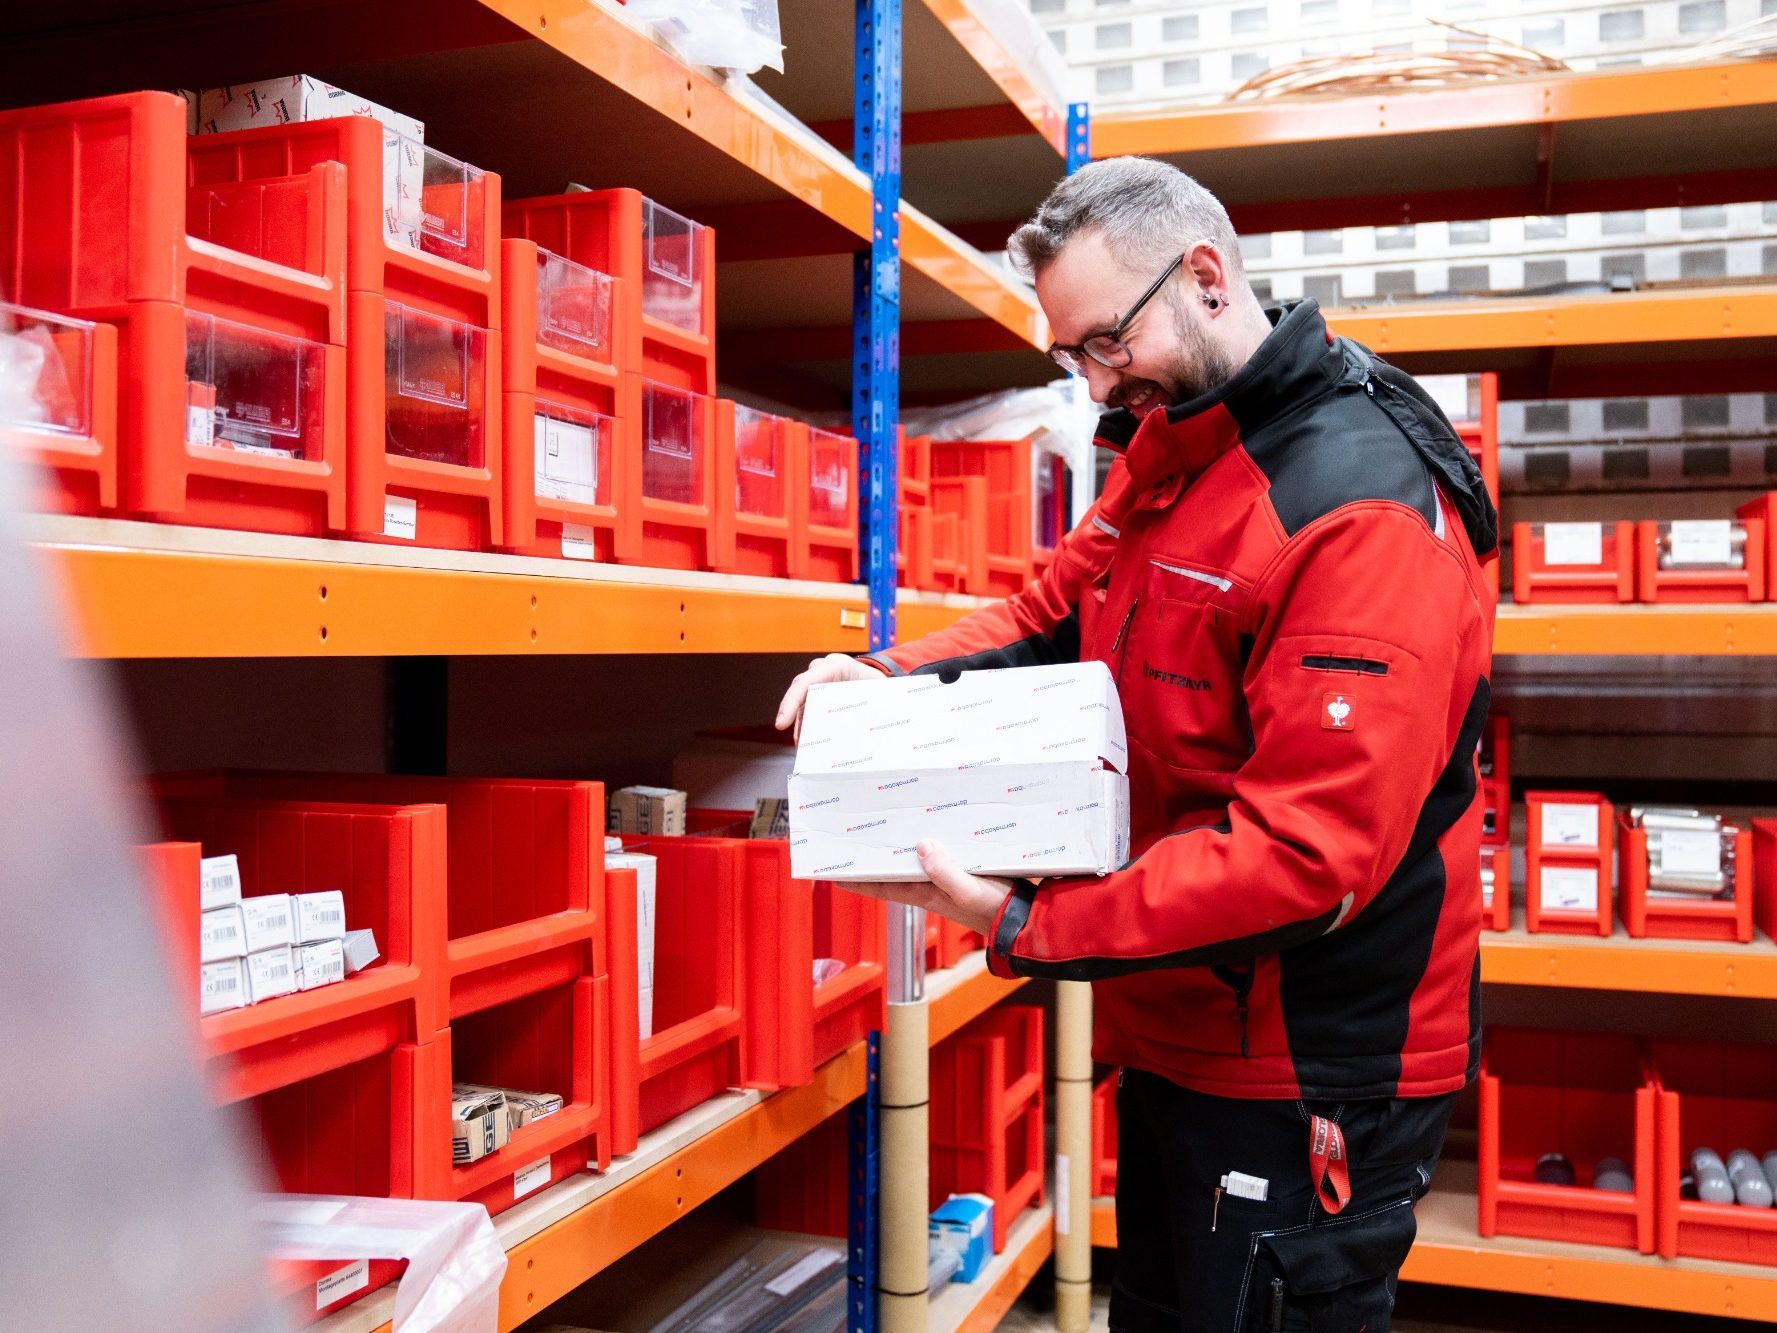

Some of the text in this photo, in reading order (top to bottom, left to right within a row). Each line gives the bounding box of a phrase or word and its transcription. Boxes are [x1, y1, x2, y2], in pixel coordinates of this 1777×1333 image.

[884, 777, 919, 789] dormakaba
[805, 797, 840, 809] dormakaba
[932, 799, 968, 811] dormakaba
[852, 819, 887, 831] dormakaba
[980, 822, 1016, 834] dormakaba
